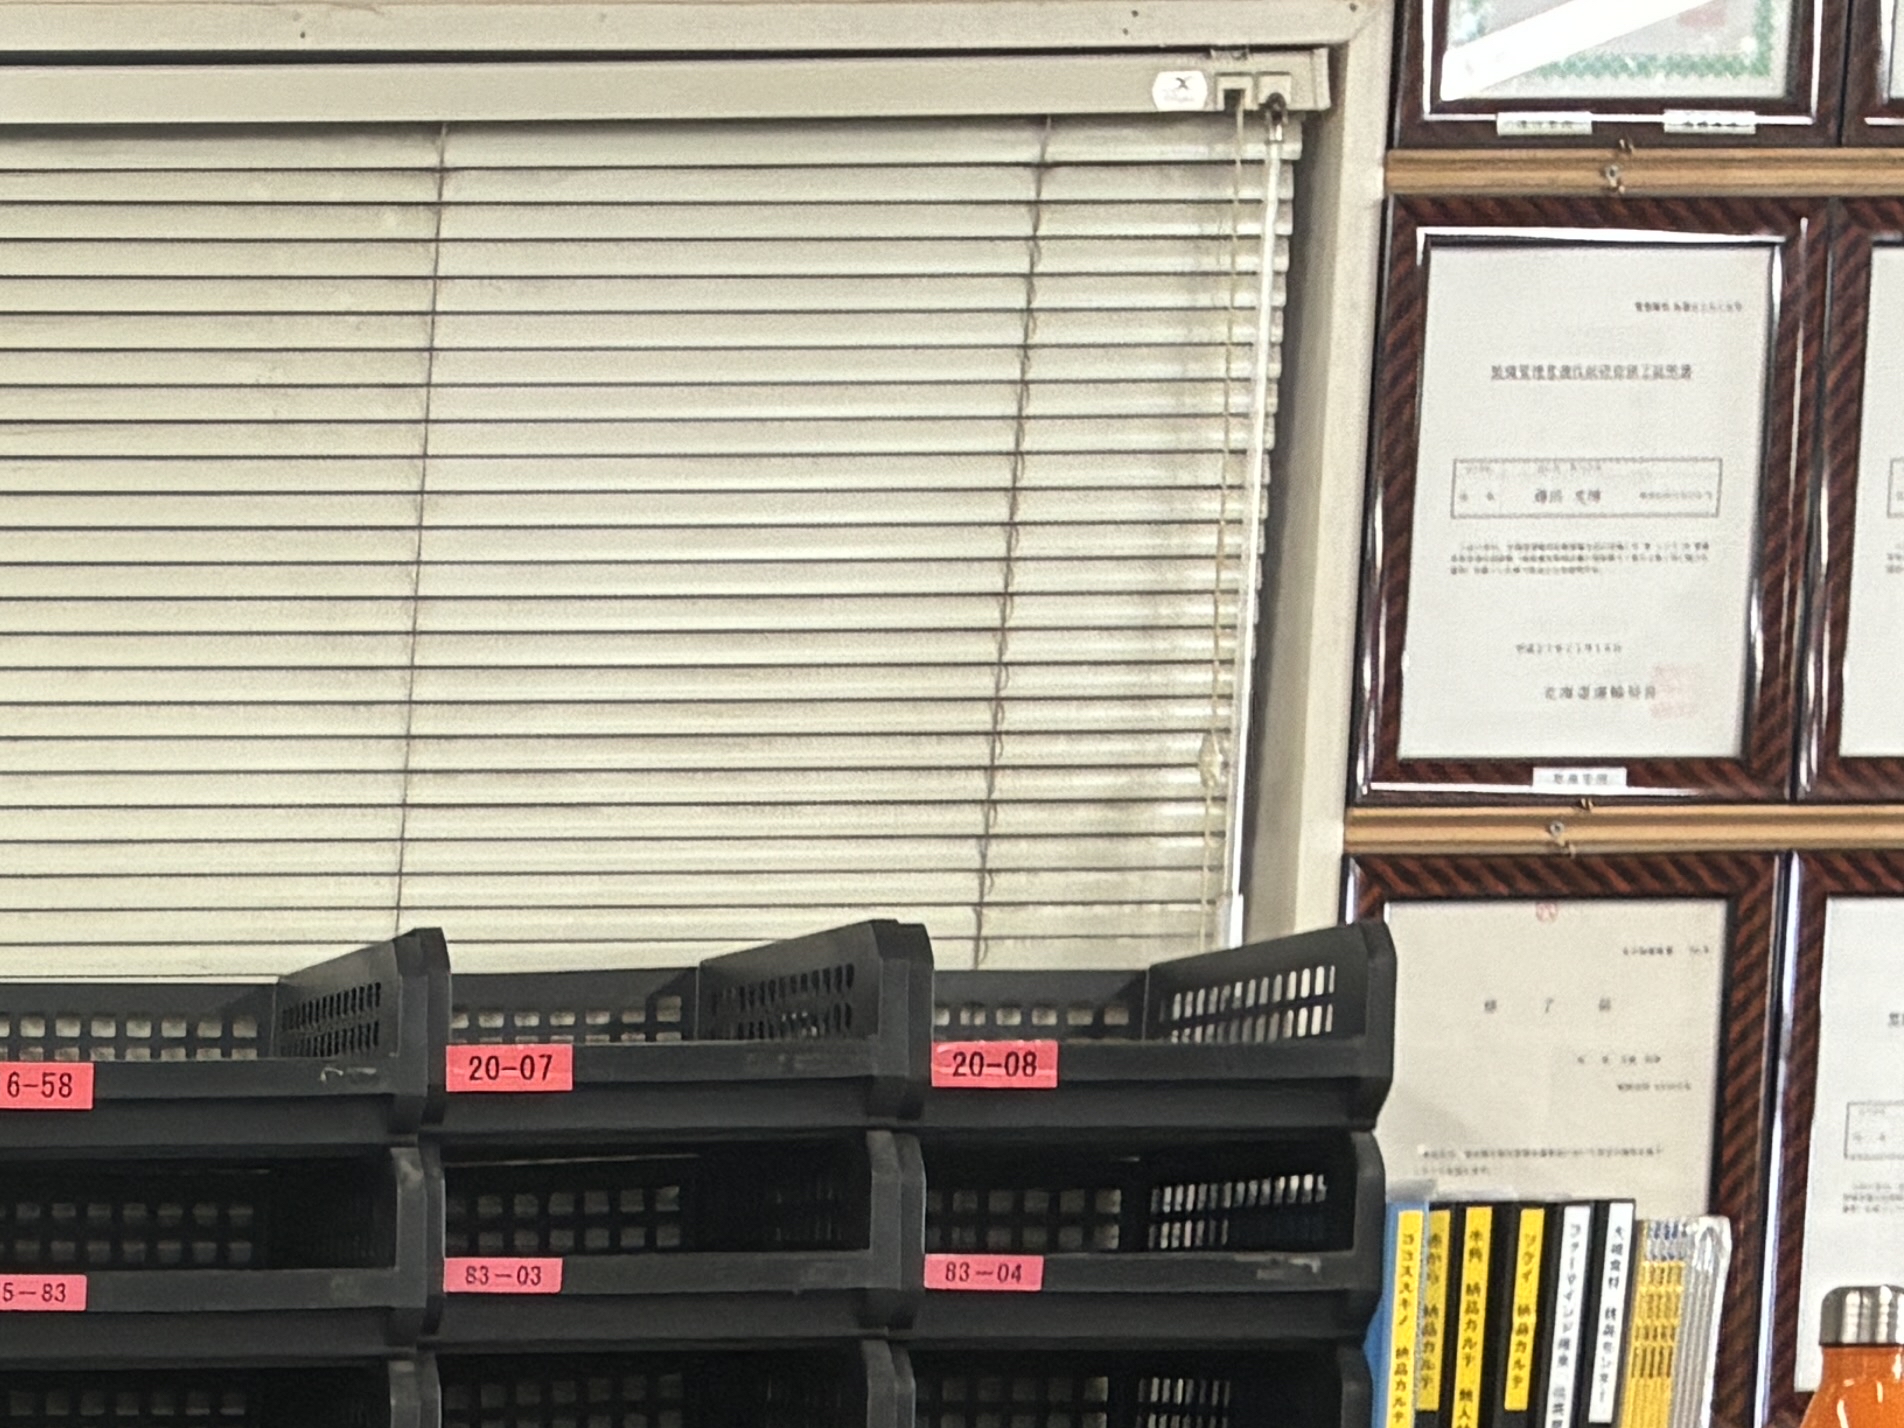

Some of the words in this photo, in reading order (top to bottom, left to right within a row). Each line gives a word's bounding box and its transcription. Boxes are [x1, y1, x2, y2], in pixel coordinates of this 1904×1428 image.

[467, 1053, 554, 1082] 20-07
[951, 1050, 1039, 1079] 20-08
[465, 1263, 542, 1287] 83-03
[944, 1261, 1023, 1285] 83-04
